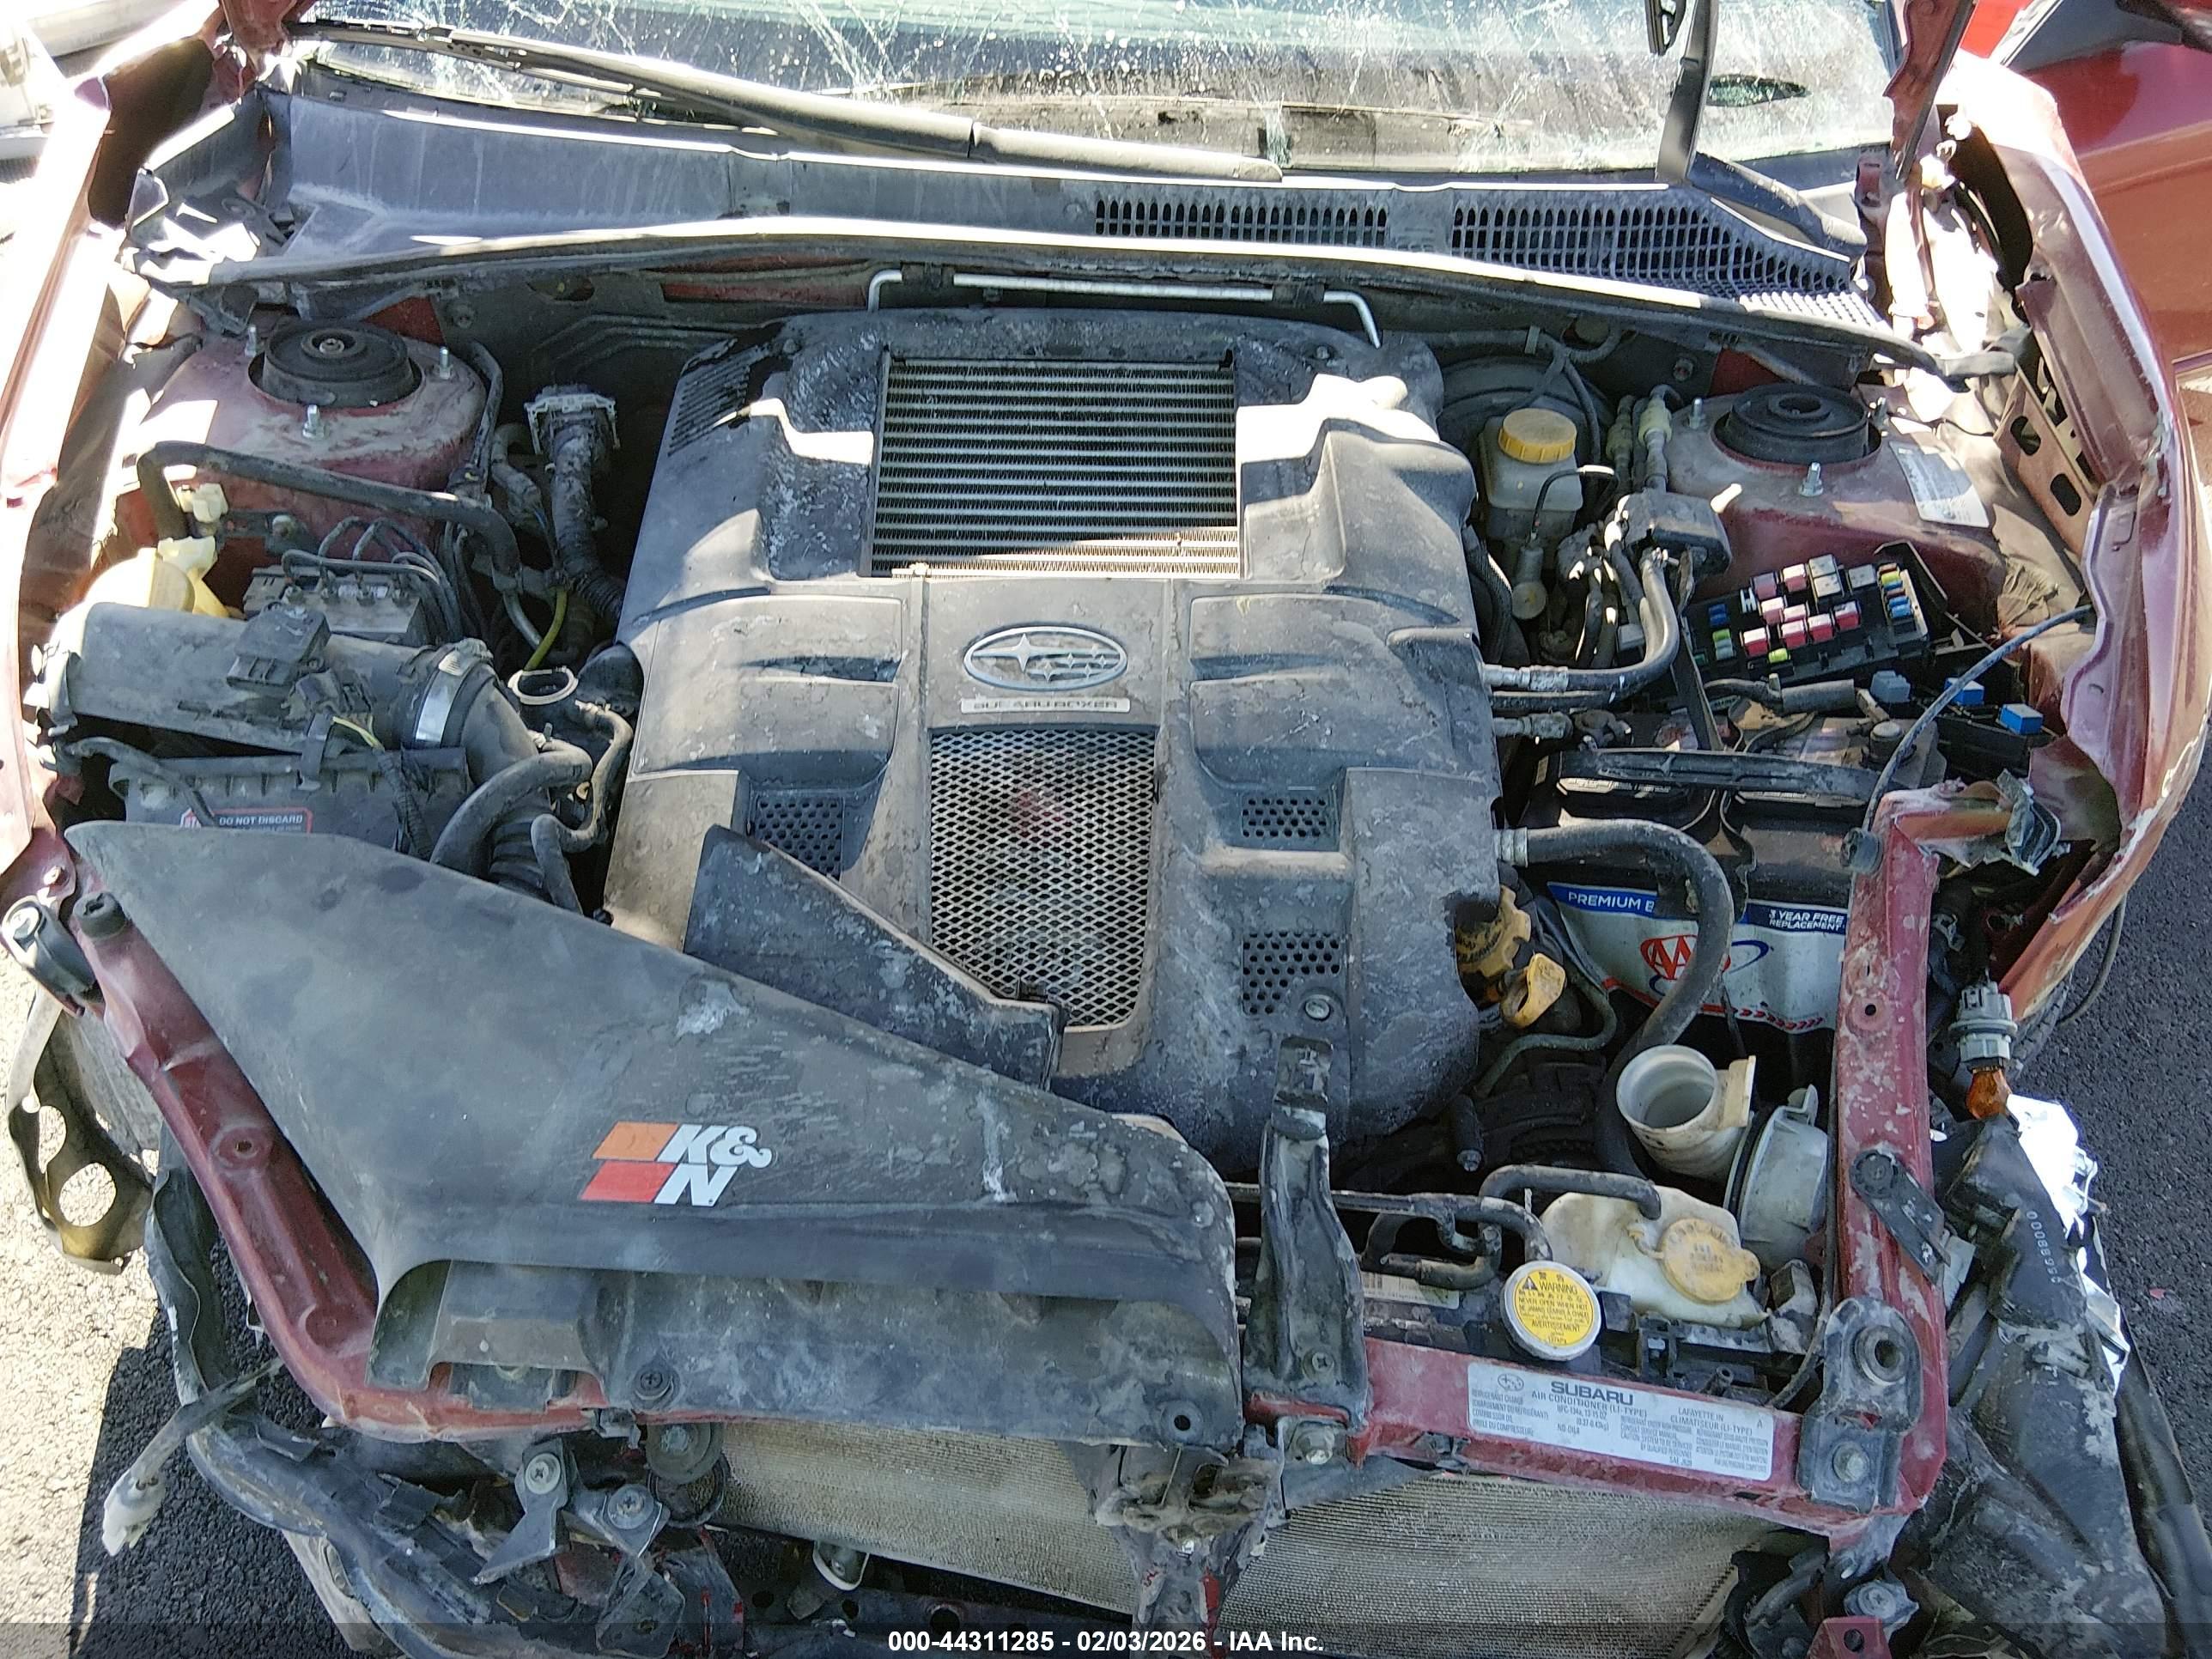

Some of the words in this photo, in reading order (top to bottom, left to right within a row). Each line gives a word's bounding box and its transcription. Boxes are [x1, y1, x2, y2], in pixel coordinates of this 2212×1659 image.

[219, 816, 234, 826] DO
[235, 816, 256, 825] NOT
[258, 815, 303, 825] DISCARD
[1568, 891, 1641, 908] PREMIUM
[1769, 908, 1777, 919] 3
[1778, 910, 1811, 921] YEAR
[1813, 912, 1844, 924] FREE
[1539, 1280, 1578, 1295] WARNING
[1531, 1389, 1547, 1401] AIR
[1548, 1393, 1608, 1411] CONDITIONER
[1550, 1381, 1633, 1406] SUBARU
[1678, 1407, 1716, 1421] LAFAYETTE
